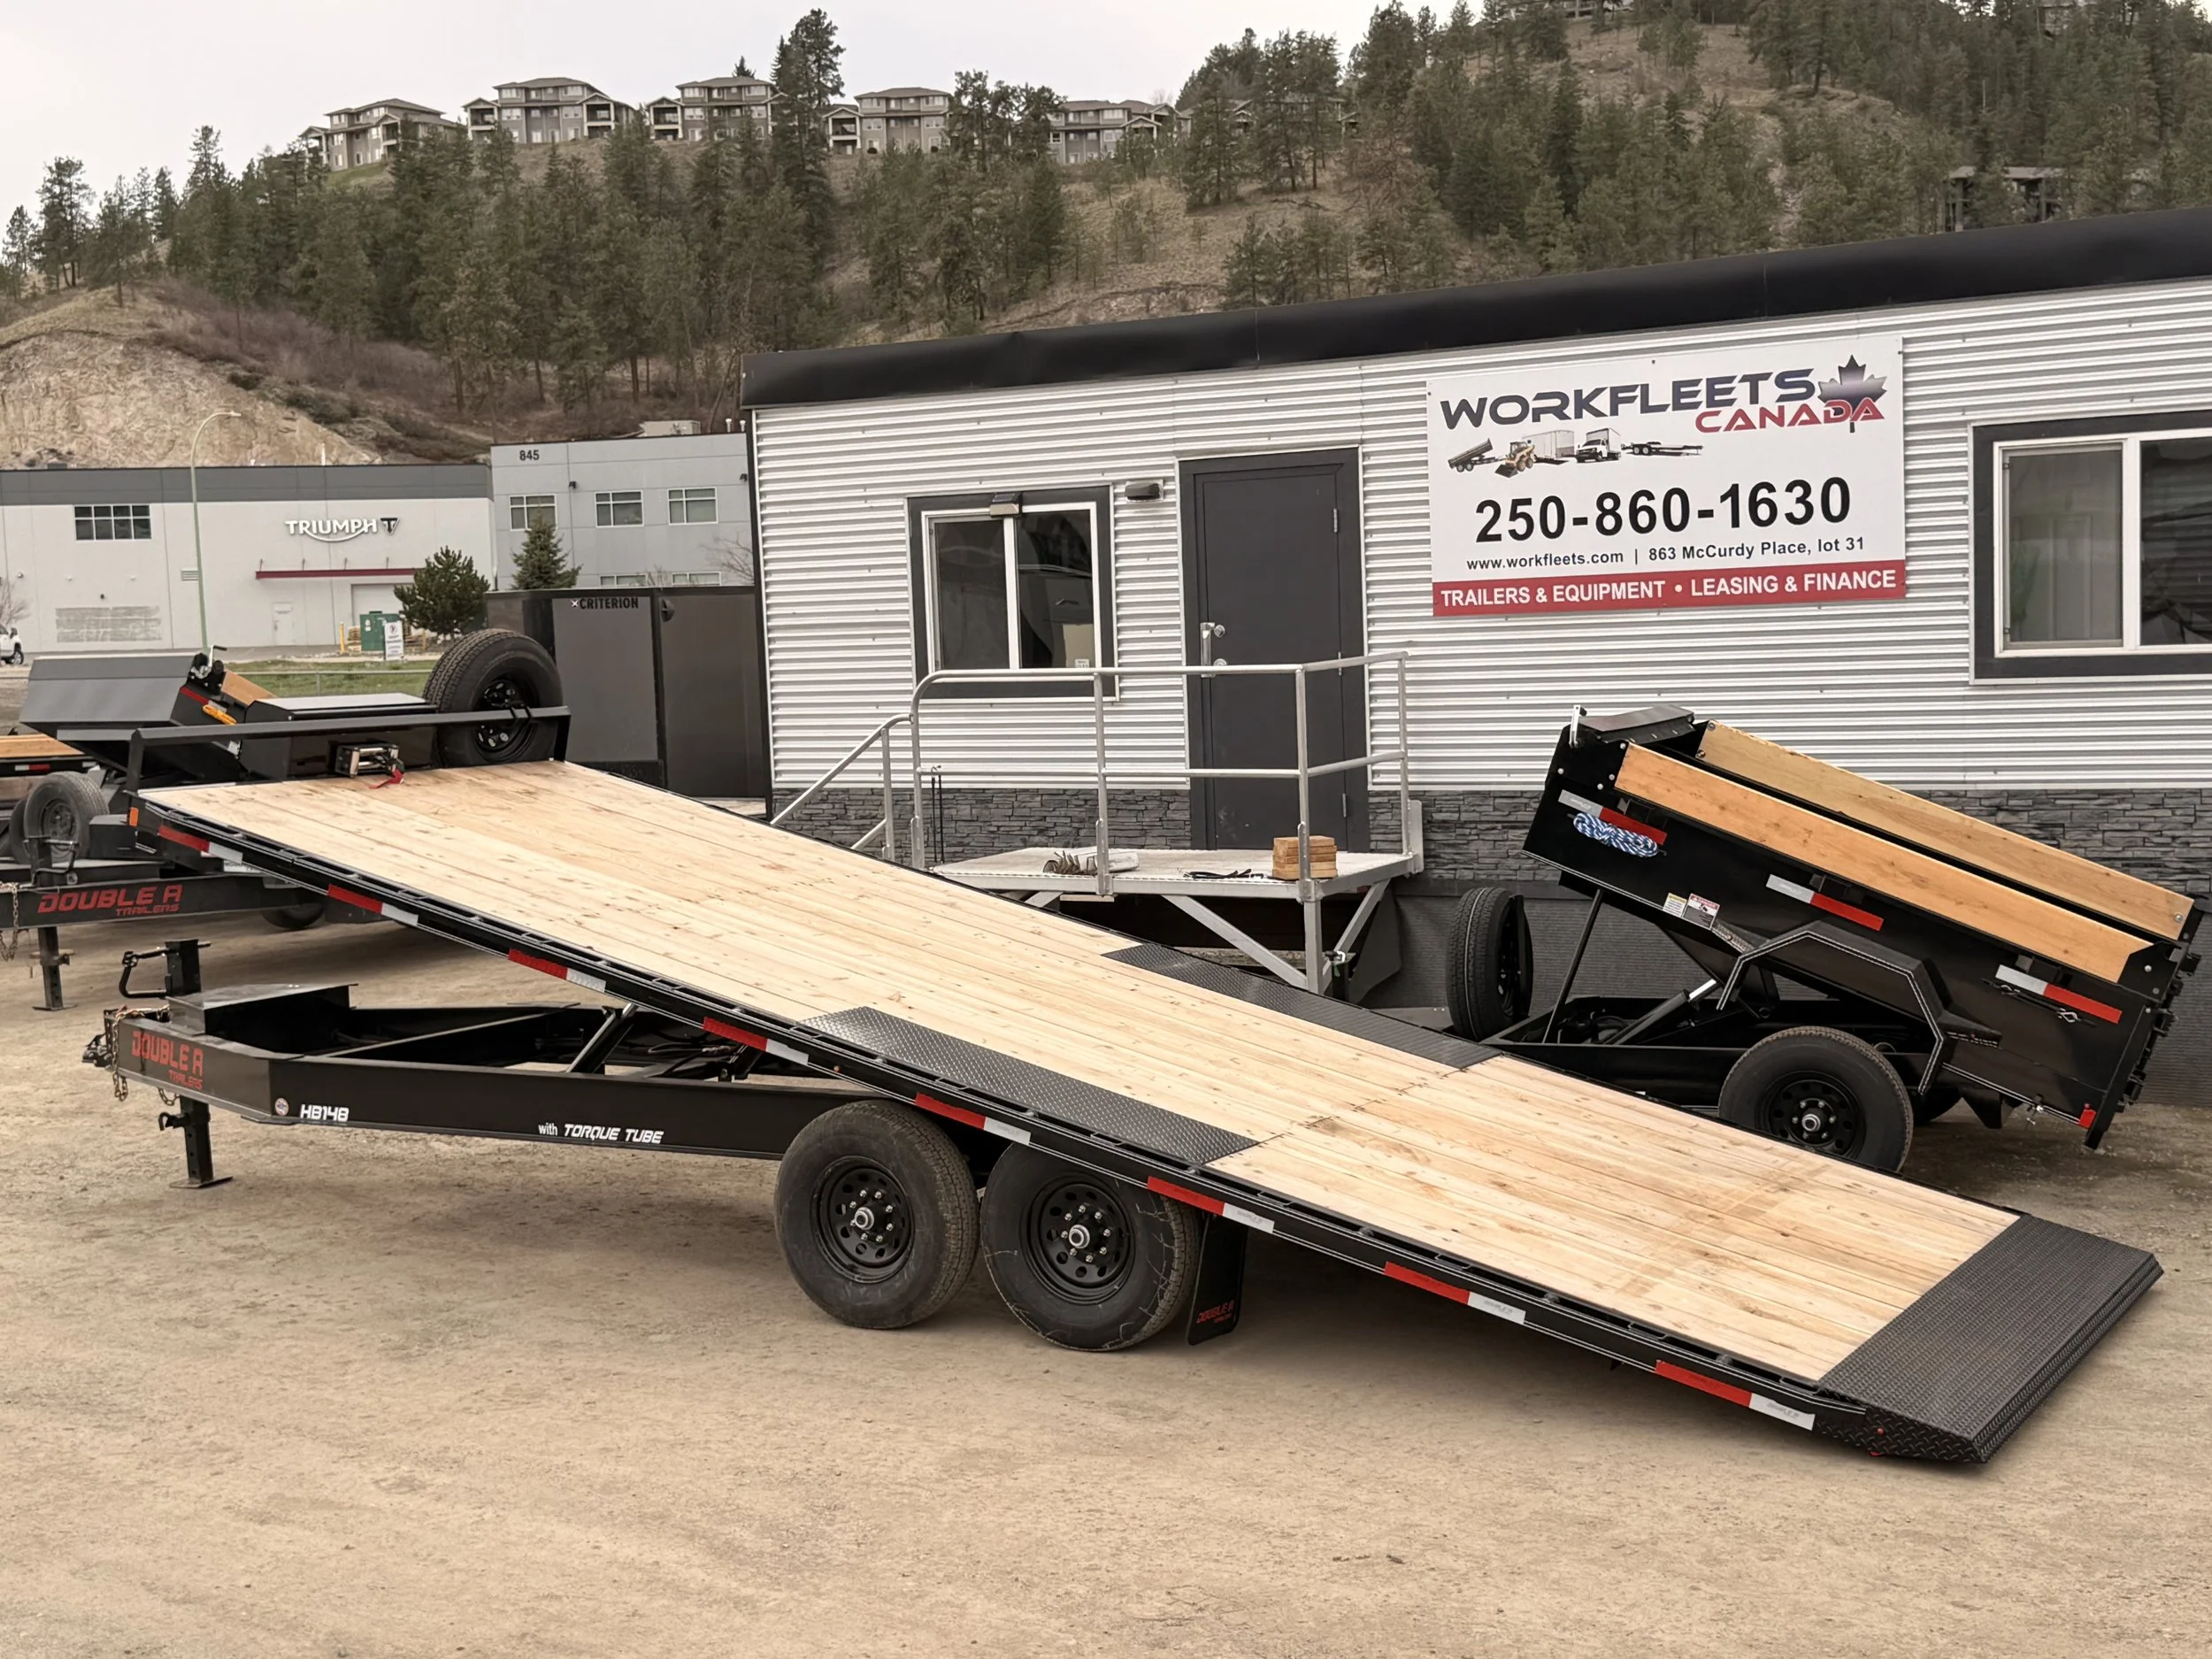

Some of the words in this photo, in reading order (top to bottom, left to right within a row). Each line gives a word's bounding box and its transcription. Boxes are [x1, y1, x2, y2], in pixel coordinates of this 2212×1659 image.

[1440, 368, 1815, 430] WORKFLEETS
[1695, 397, 1886, 434] CANADA
[519, 449, 540, 461] 845
[1475, 476, 1851, 543] 250-860-1630
[285, 518, 378, 542] TRIUMPH
[1466, 551, 1624, 570] www.workfleets.com
[1648, 546, 1677, 562] 863
[1682, 542, 1755, 559] McCurdy
[1761, 540, 1812, 555] Place,
[1817, 537, 1840, 552] lot
[1846, 536, 1864, 550] 31
[1440, 587, 1531, 607] TRAILERS
[1536, 588, 1548, 603] &
[1553, 580, 1666, 603] EQUIPMENT
[1691, 575, 1778, 596] LEASING
[1785, 576, 1798, 592] &
[1803, 570, 1896, 591] FINANCE
[580, 597, 639, 610] CRITERION
[37, 887, 157, 914] DOUBLE
[162, 884, 184, 903] A
[116, 903, 180, 917] TRAILERS
[132, 1031, 191, 1072] DOUBLE
[192, 1048, 204, 1077] A
[300, 1103, 349, 1122] HB148
[538, 1122, 558, 1136] with
[564, 1124, 621, 1141] TORQUE
[625, 1128, 664, 1144] TUBE
